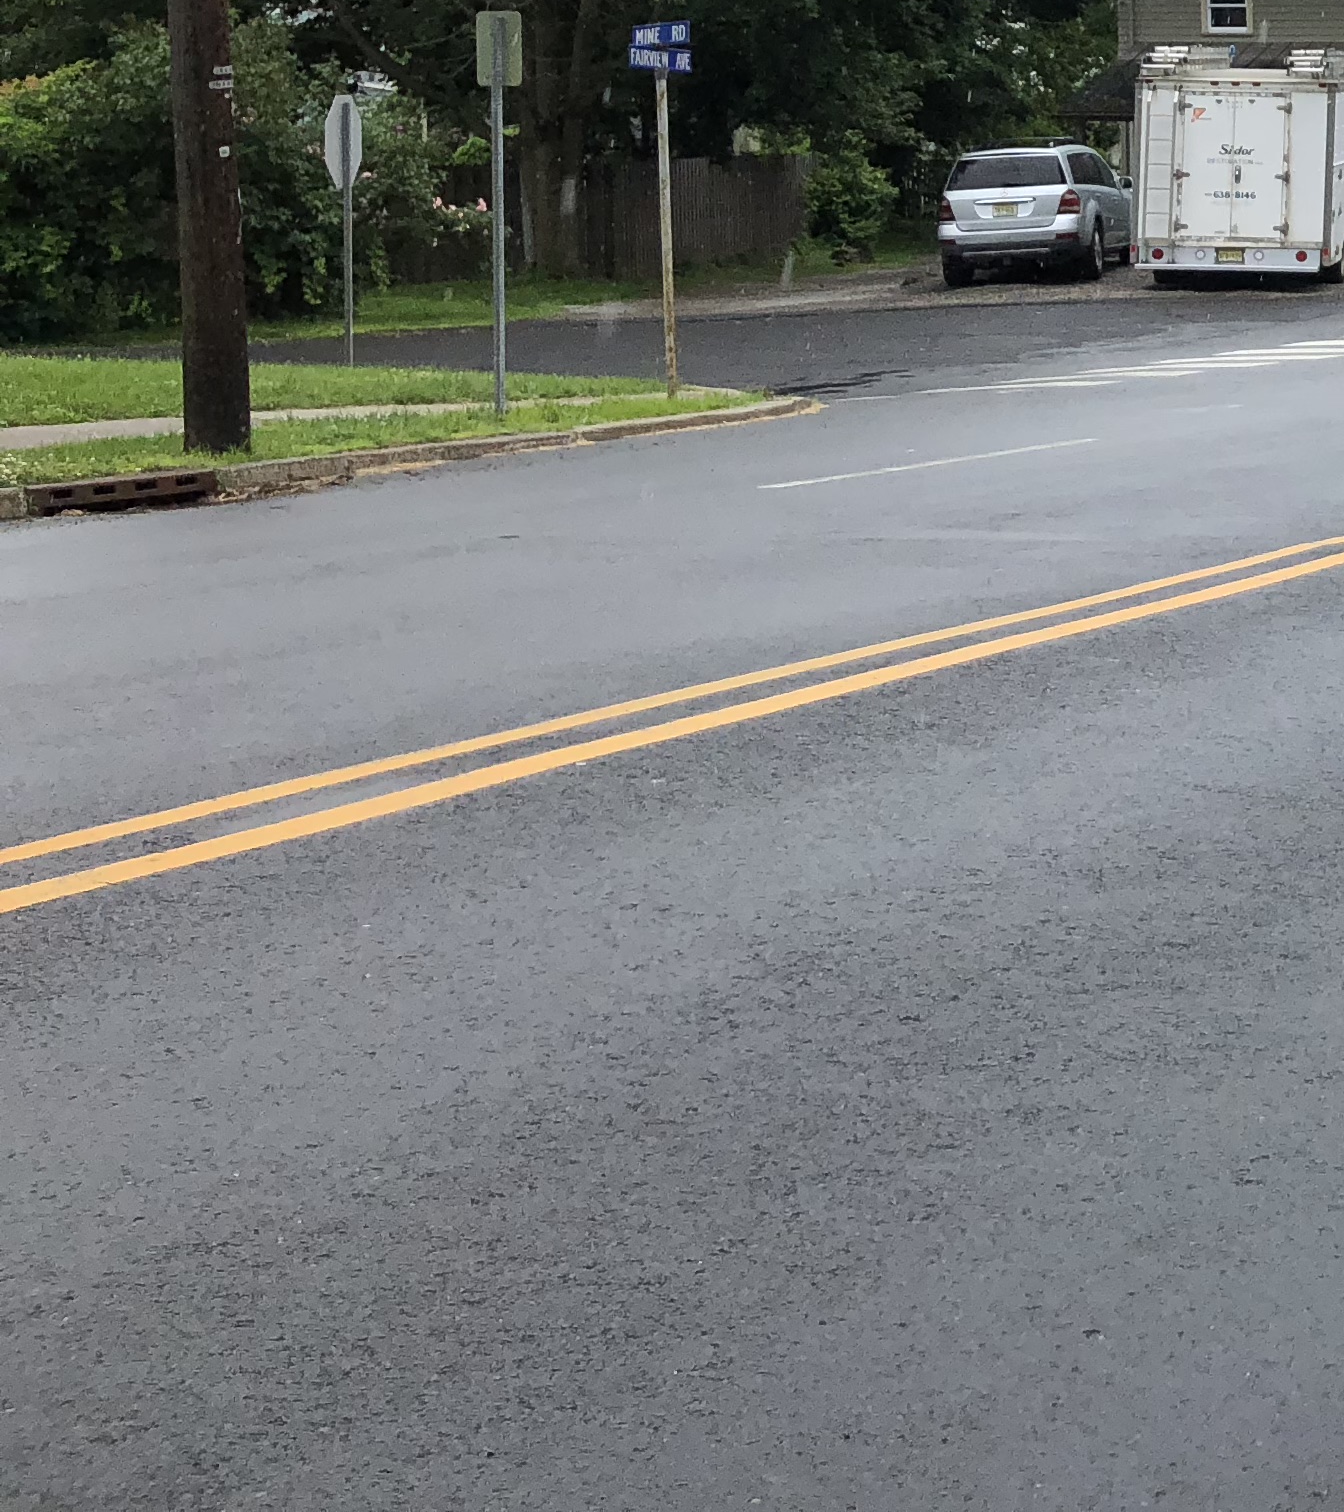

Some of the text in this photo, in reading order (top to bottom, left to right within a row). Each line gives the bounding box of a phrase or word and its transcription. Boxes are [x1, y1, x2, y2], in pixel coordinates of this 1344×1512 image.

[635, 24, 686, 45] MINE RD
[630, 47, 691, 71] FAIRVIEW AVE
[1218, 143, 1255, 156] Sidor
